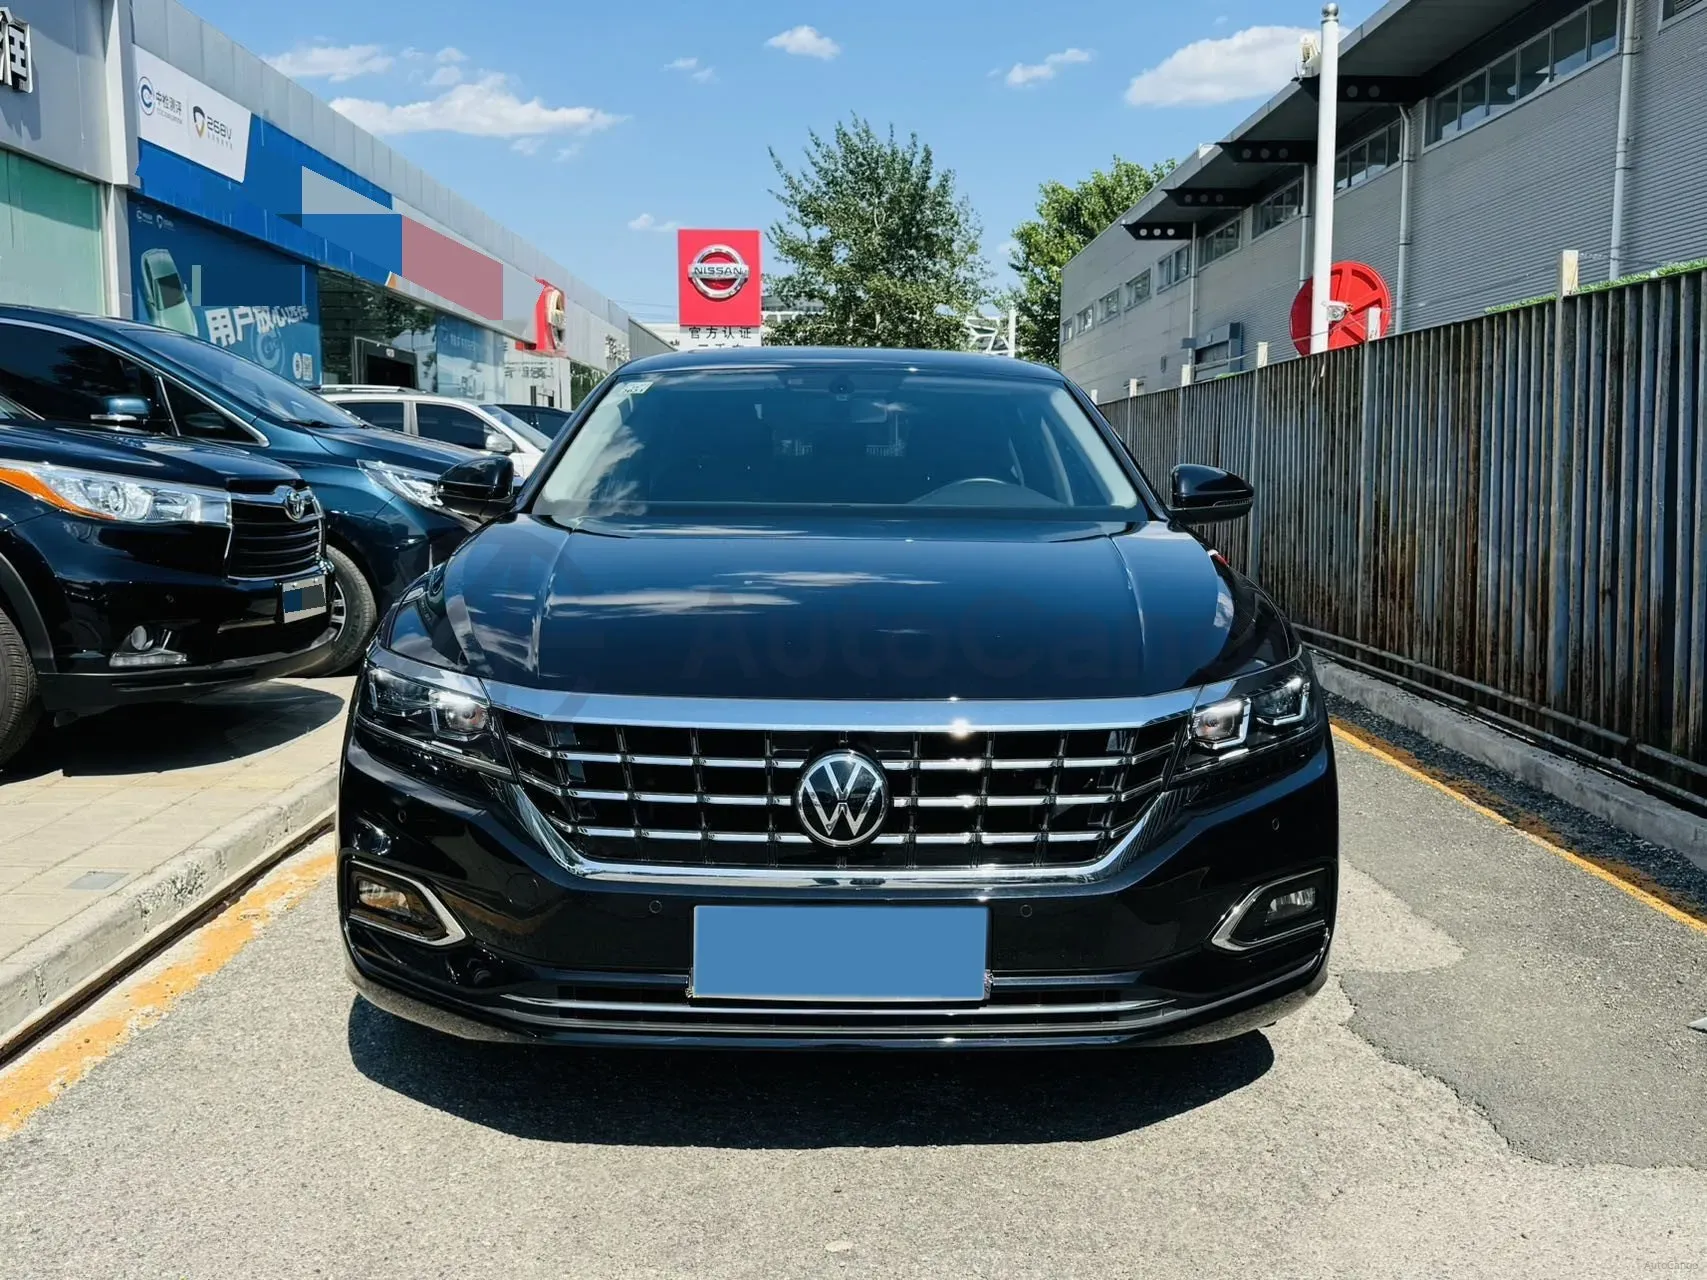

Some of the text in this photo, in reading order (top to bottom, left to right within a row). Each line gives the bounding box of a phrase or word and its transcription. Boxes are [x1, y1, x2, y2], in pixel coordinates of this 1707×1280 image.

[693, 266, 742, 275] NISSAN
[689, 326, 751, 339] 官方认证
